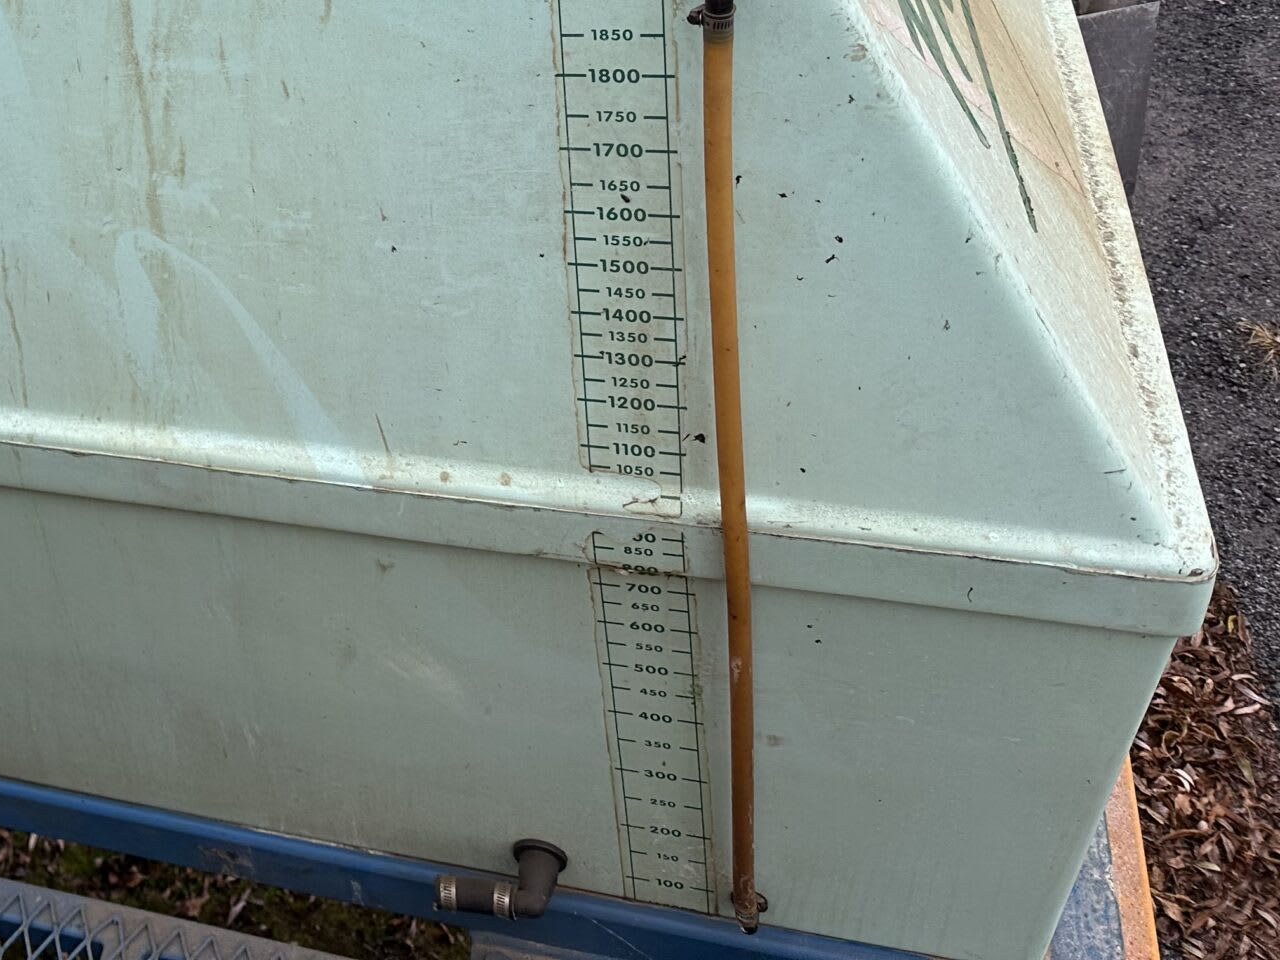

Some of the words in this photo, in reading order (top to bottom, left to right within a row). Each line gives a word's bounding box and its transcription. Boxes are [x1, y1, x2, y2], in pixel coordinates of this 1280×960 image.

[591, 29, 633, 41] 1850
[588, 68, 640, 84] 1800
[596, 111, 637, 123] 1750
[593, 142, 643, 158] 1700
[600, 179, 641, 192] 1650
[597, 207, 647, 222] 1600
[603, 234, 643, 247] 1550
[600, 259, 649, 274] 1500
[606, 287, 646, 299] 1450
[602, 308, 652, 323] 1400
[608, 330, 648, 344] 1350
[605, 351, 653, 368] 1300
[611, 376, 650, 390] 1250
[608, 395, 656, 411] 1200
[616, 422, 650, 435] 1150
[612, 442, 656, 458] 1100
[617, 464, 654, 477] 1050
[624, 546, 653, 557] 850
[625, 582, 662, 595] 700
[631, 602, 660, 612] 650
[629, 621, 665, 633] 600
[635, 643, 663, 653] 550
[634, 663, 669, 676] 500
[640, 688, 667, 698] 450
[638, 712, 672, 724] 400
[644, 740, 671, 750] 350
[644, 769, 677, 782] 300
[650, 798, 676, 808] 250
[650, 826, 681, 838] 200
[657, 853, 679, 862] 150
[656, 879, 684, 890] 100
